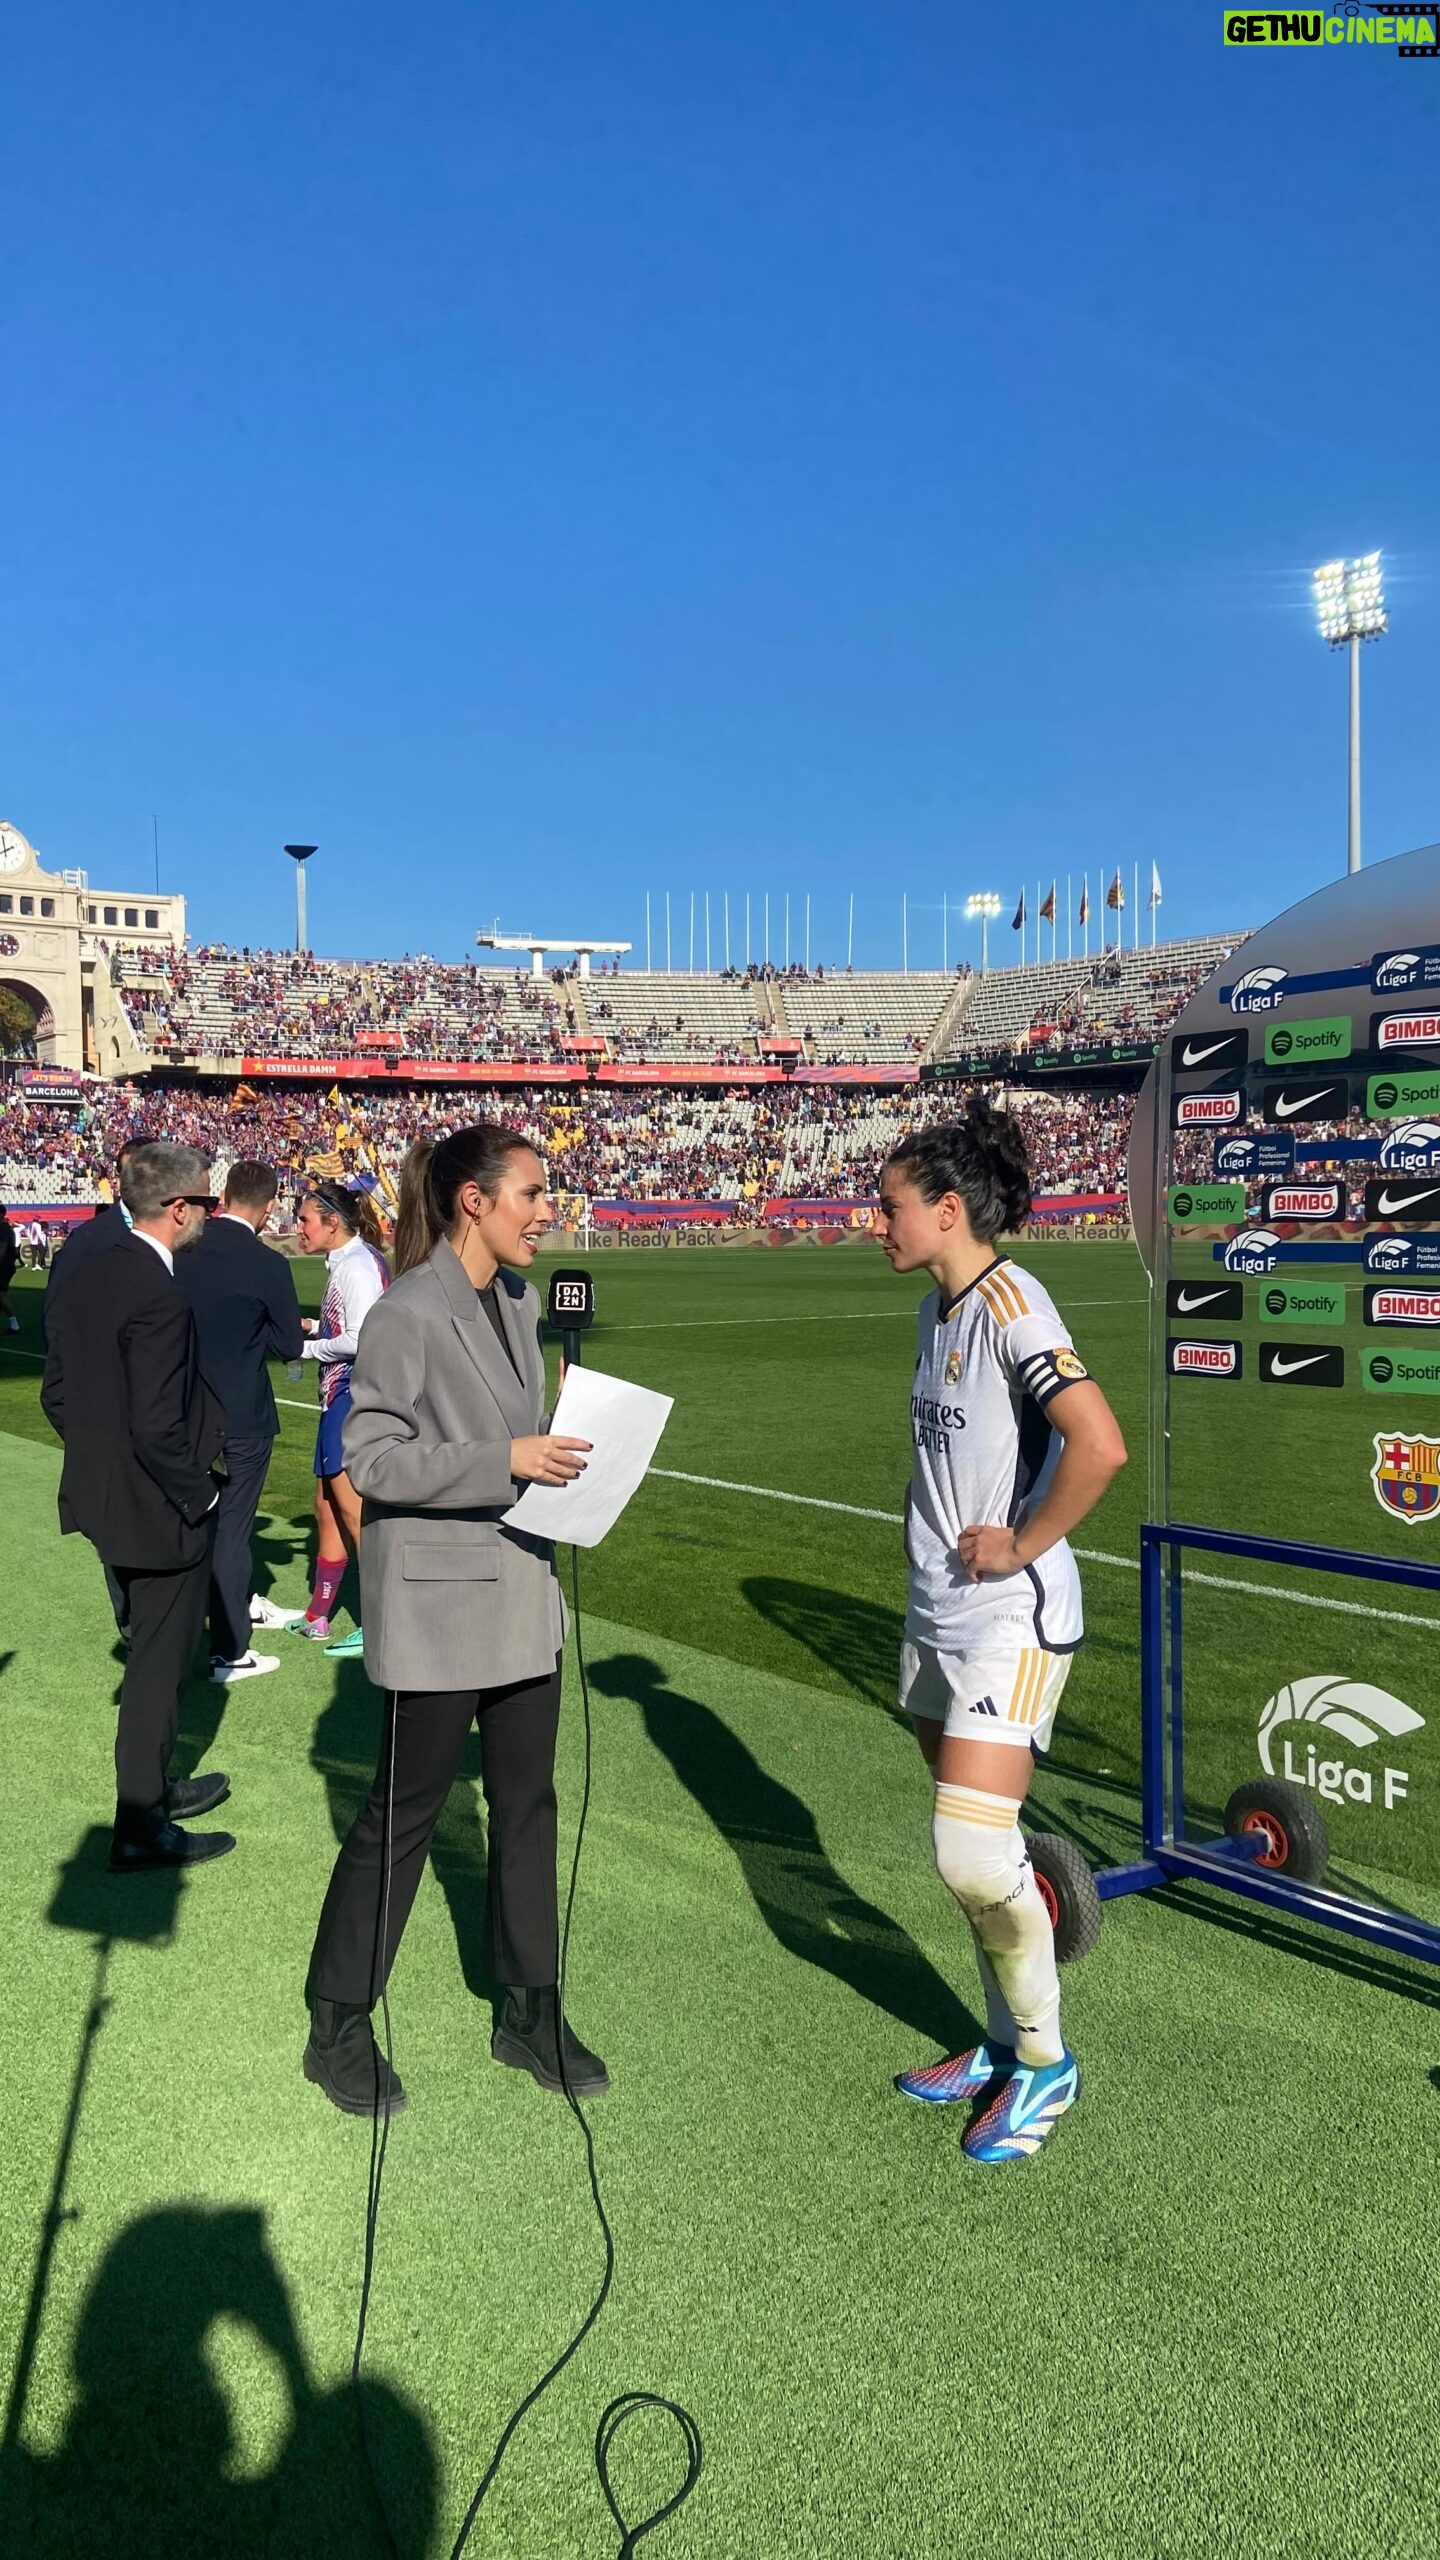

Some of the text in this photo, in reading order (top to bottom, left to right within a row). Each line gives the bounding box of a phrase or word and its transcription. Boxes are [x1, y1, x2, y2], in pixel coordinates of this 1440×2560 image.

[1383, 971, 1417, 987] Liga F
[1240, 991, 1284, 1012] Liga F
[1384, 1019, 1440, 1040] BIMB
[1295, 1031, 1342, 1050] Spotify
[266, 1064, 336, 1074] ESTRELLA DAMM
[25, 1087, 79, 1096] BARCELONA
[1182, 1099, 1236, 1118] BIMBO
[1223, 1157, 1252, 1169] Liga F
[1391, 1150, 1440, 1170] Liga F
[1195, 1197, 1237, 1213] Spotify
[1274, 1193, 1333, 1211] BIMBO
[574, 1231, 716, 1248] Nike Ready Pack
[1027, 1225, 1130, 1241] Nike Ready
[1233, 1255, 1277, 1275] Liga F
[1375, 1257, 1409, 1270] Liga F
[1290, 1296, 1336, 1313] Spotify
[1178, 1349, 1231, 1368] BIMBO
[1284, 1740, 1409, 1810] Liga F
